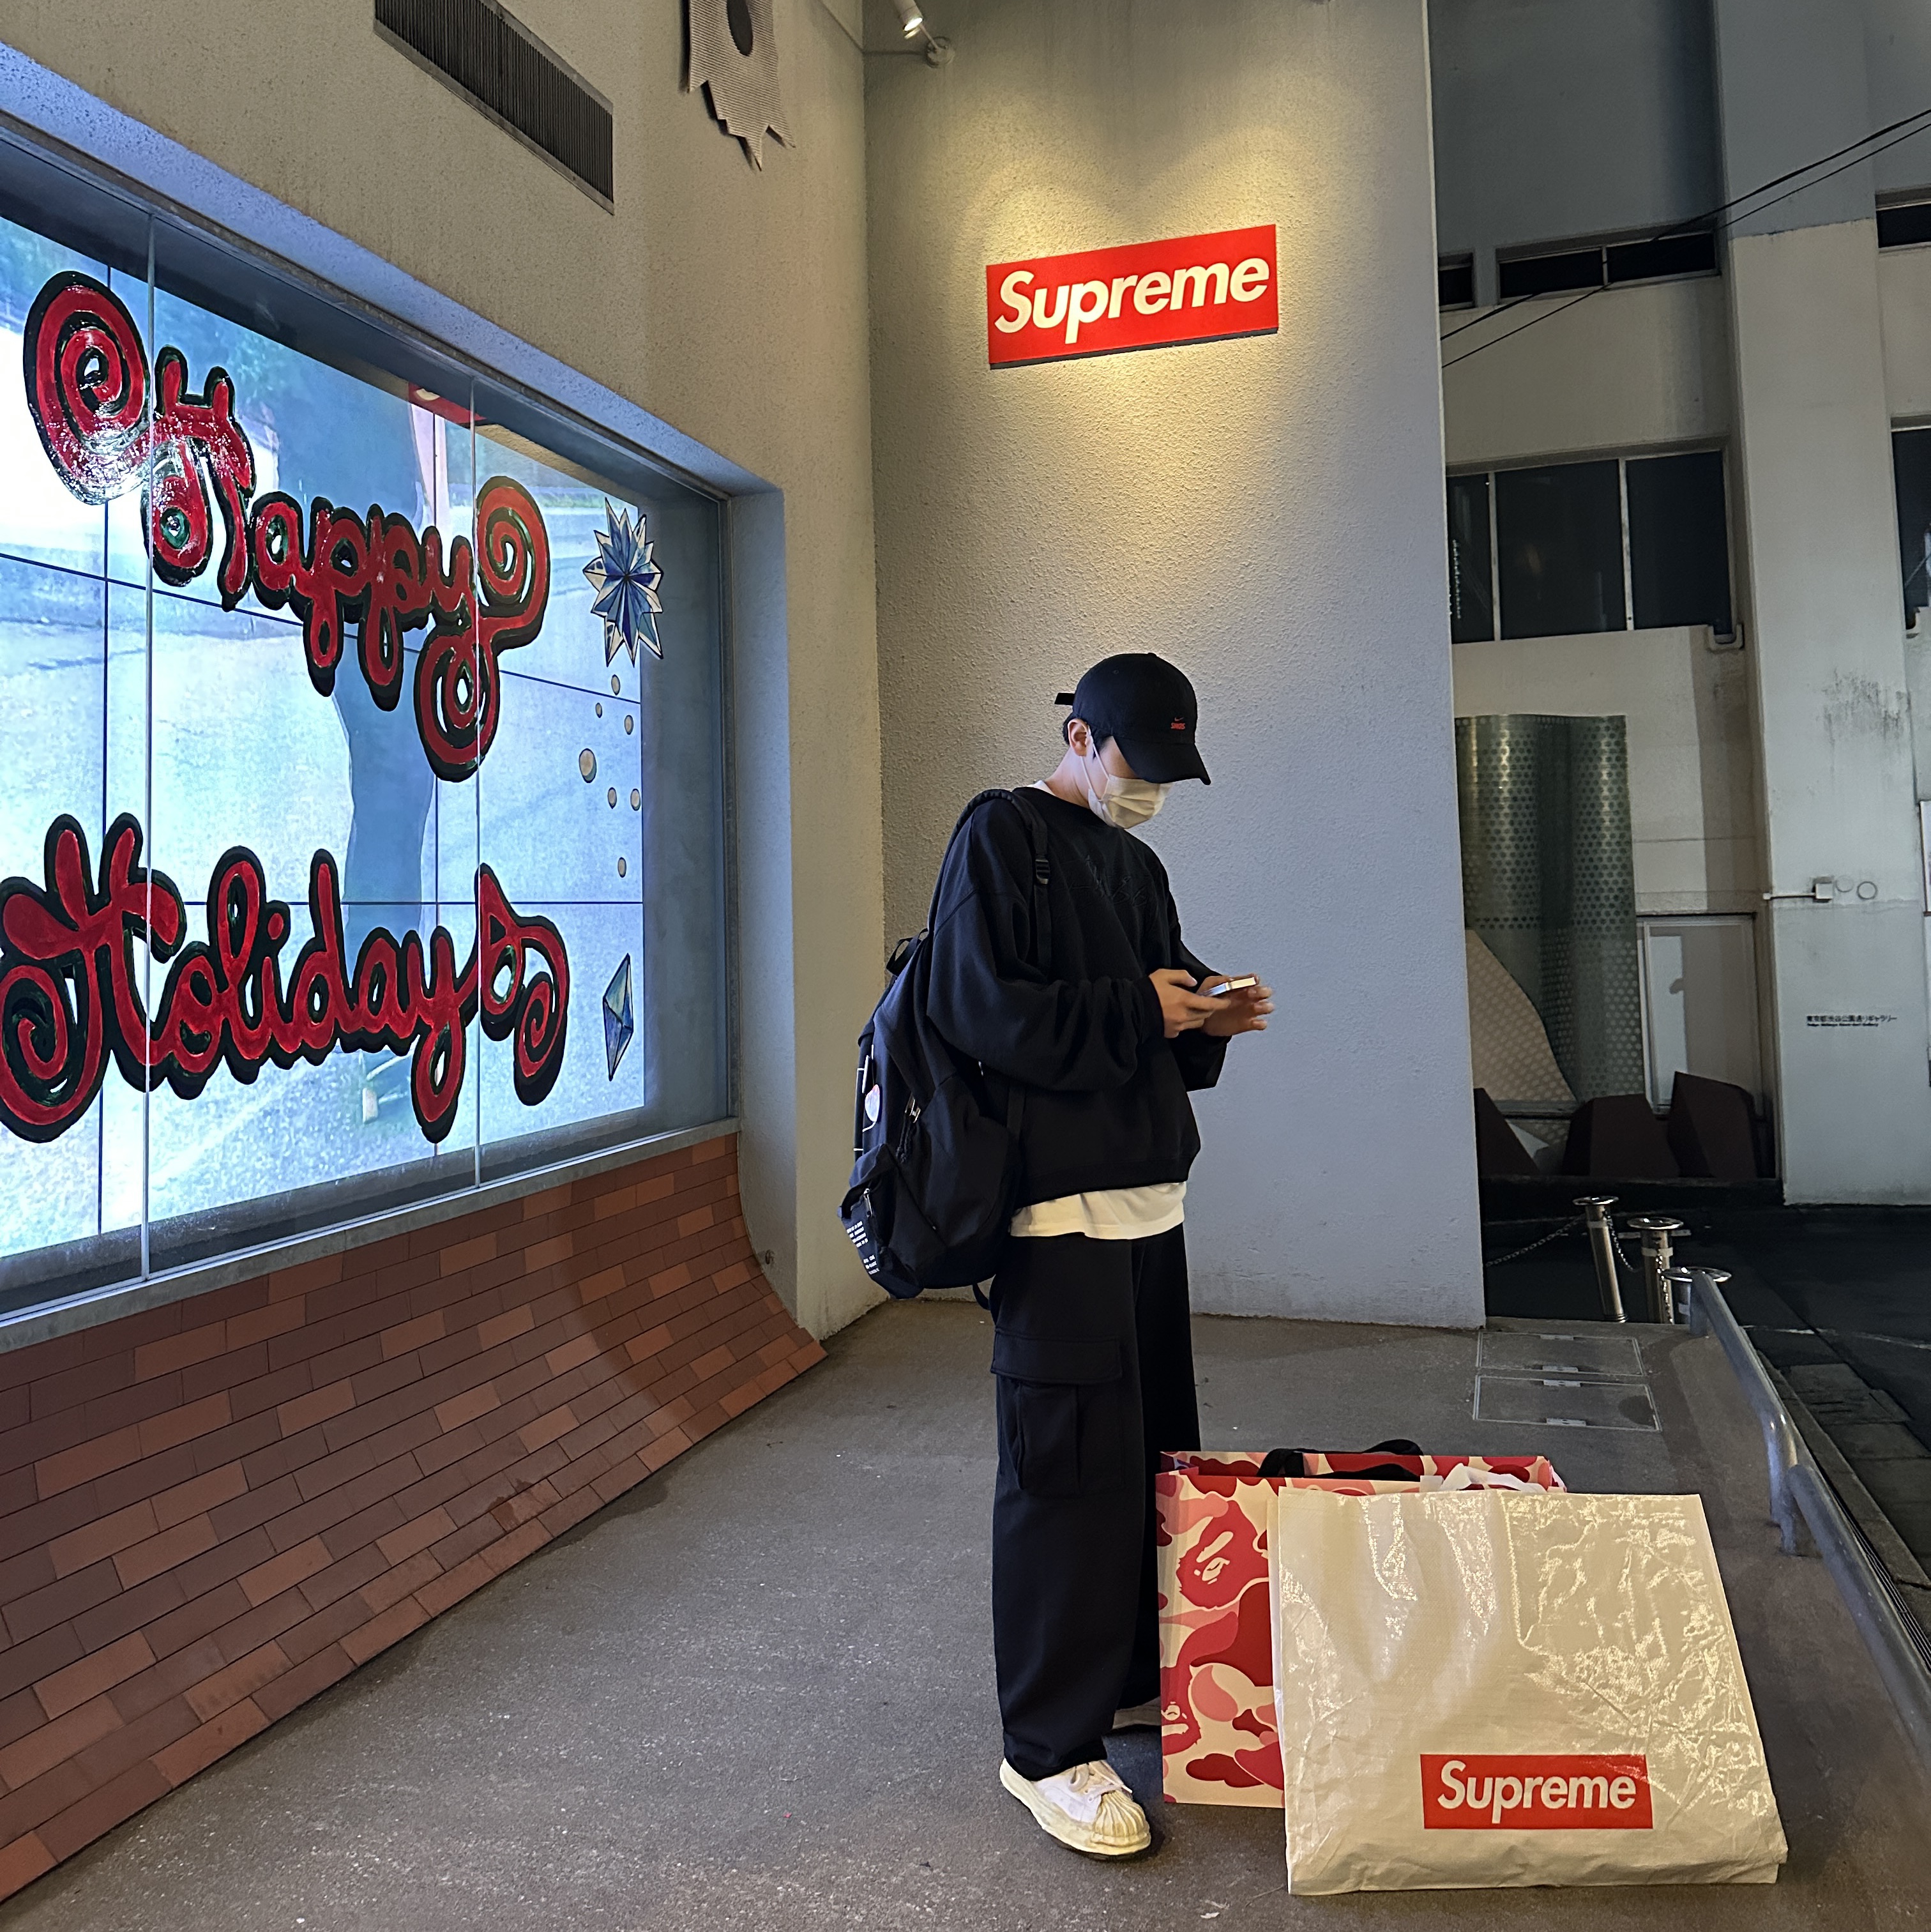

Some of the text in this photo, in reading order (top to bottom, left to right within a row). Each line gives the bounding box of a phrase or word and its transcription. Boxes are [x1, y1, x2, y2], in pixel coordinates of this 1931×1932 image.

[994, 257, 1270, 344] Supreme
[23, 271, 550, 782] Happy
[0, 812, 570, 1144] Holidays
[1437, 1760, 1637, 1824] Supreme
